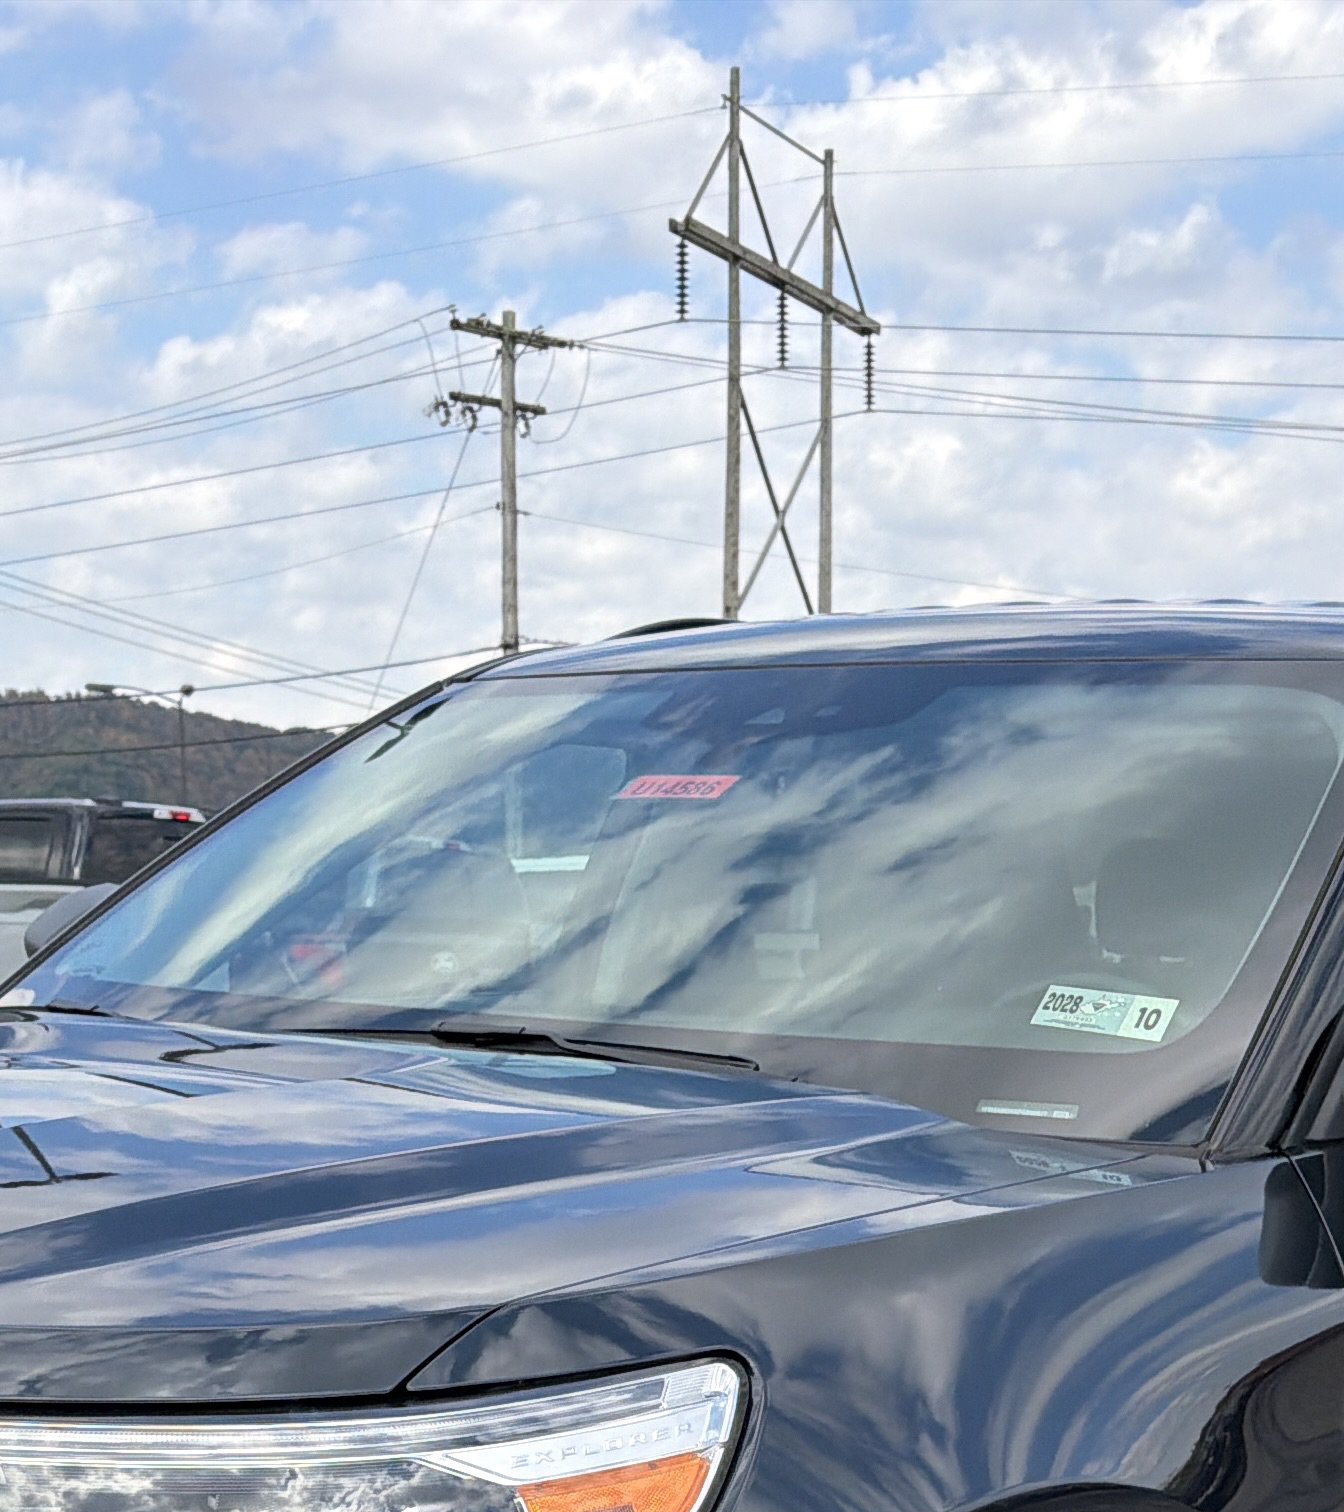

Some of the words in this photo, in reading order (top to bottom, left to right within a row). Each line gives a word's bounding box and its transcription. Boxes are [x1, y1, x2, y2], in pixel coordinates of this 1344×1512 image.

[1042, 991, 1084, 1014] 2028
[1133, 1007, 1162, 1031] 10
[510, 1421, 694, 1469] EXPLORER
